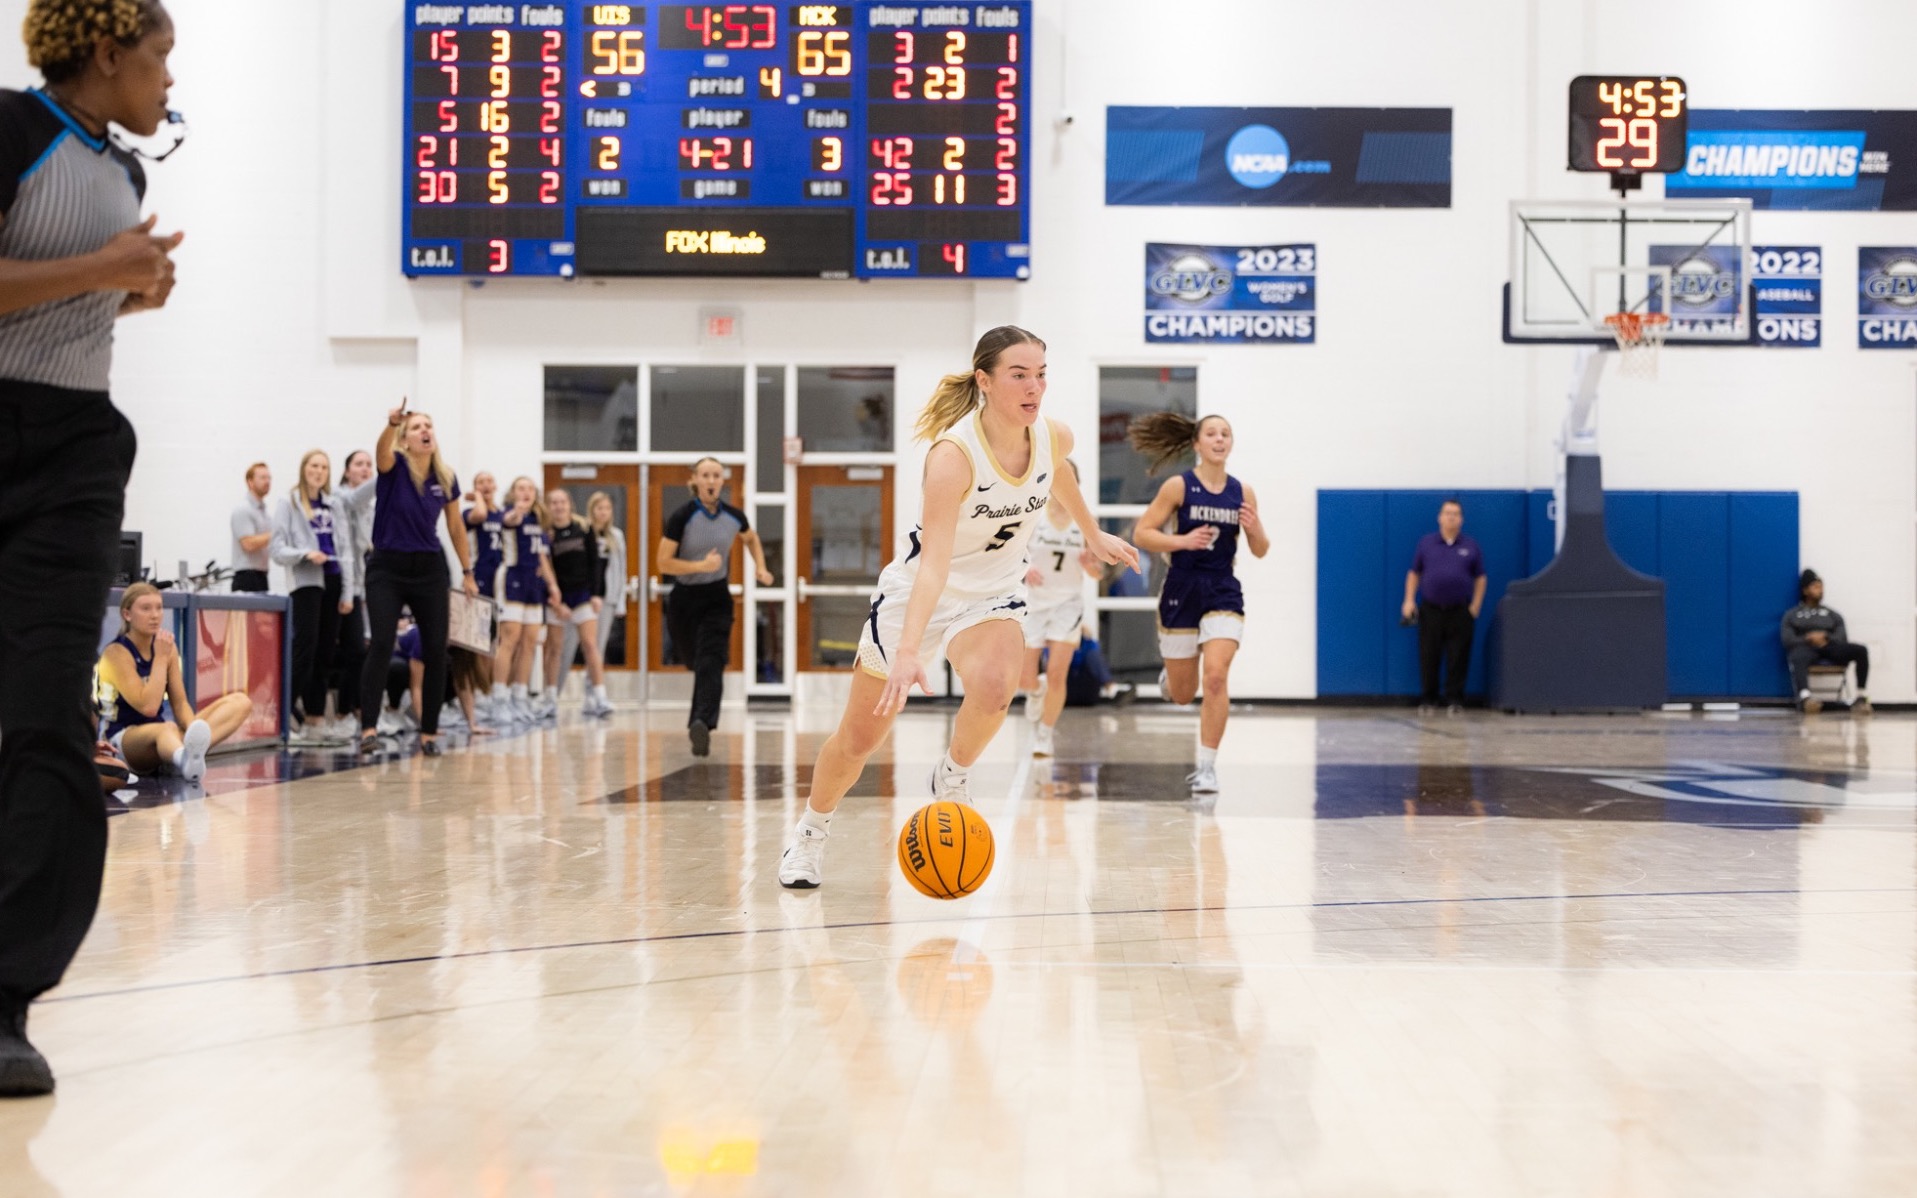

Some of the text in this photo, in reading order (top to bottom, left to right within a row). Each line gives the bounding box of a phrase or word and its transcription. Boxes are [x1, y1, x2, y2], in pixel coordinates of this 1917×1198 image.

[415, 4, 563, 26] player points fouls
[593, 4, 630, 25] UIS
[685, 5, 776, 48] 4:53
[799, 5, 837, 26] MCK
[869, 5, 1018, 28] player points fouls
[431, 30, 561, 63] 15 3 2
[592, 31, 645, 75] 56
[798, 31, 851, 75] 65
[895, 31, 1017, 64] 3 2 1
[440, 64, 561, 98] 7 9 2
[689, 68, 781, 97] period 4
[893, 66, 1017, 100] 2 23 2
[1599, 80, 1681, 118] 4:53
[438, 100, 560, 134] 5 16 2
[586, 108, 626, 127] fouls
[689, 107, 743, 128] player
[808, 109, 847, 128] fouls
[995, 102, 1016, 135] 2
[418, 135, 560, 169] 21 2 4
[599, 136, 619, 170] 2
[821, 137, 842, 171] 3
[872, 138, 1016, 170] 42 2 2
[1597, 118, 1658, 168] 29
[1686, 145, 1859, 177] CHAMPIONS
[419, 170, 559, 204] 30 5 2
[588, 180, 621, 195] won
[694, 180, 737, 199] game
[810, 181, 842, 196] won
[872, 173, 1016, 205] 25 11 3
[489, 240, 507, 272] 3
[665, 230, 709, 253] FOX
[943, 244, 964, 273] 4
[1236, 248, 1315, 272] 2023
[1757, 288, 1815, 302] ASEBALL
[1148, 315, 1312, 338] CHAMPIONS
[971, 503, 1021, 518] Prairie
[985, 521, 1022, 551] 5
[1052, 551, 1065, 571] 7
[905, 810, 926, 873] Wilson
